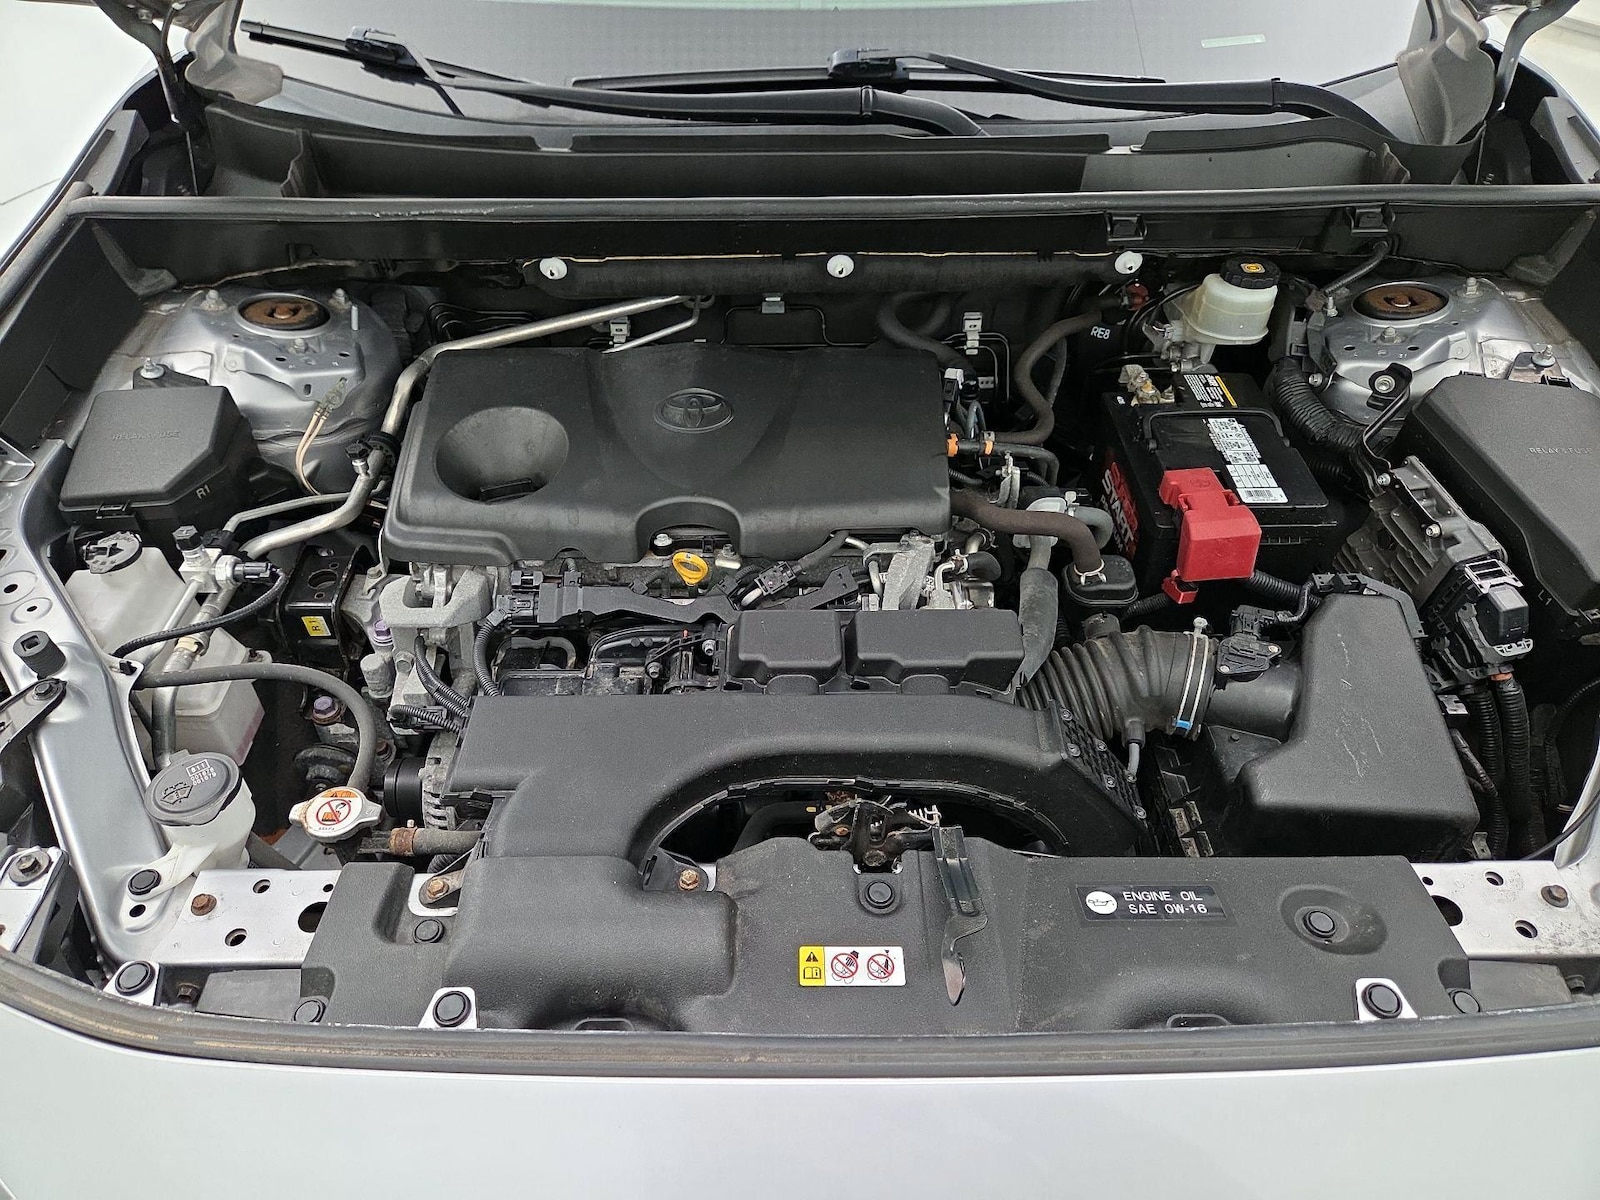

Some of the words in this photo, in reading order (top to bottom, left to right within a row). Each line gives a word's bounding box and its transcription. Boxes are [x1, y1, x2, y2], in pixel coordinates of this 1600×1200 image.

[1090, 326, 1111, 340] RE8
[195, 484, 211, 500] R1
[1102, 468, 1135, 551] START
[1537, 589, 1552, 606] L1
[1122, 890, 1174, 902] ENGINE
[1180, 891, 1204, 902] OIL
[1127, 903, 1158, 915] SAE
[1164, 903, 1208, 915] 0W-16
